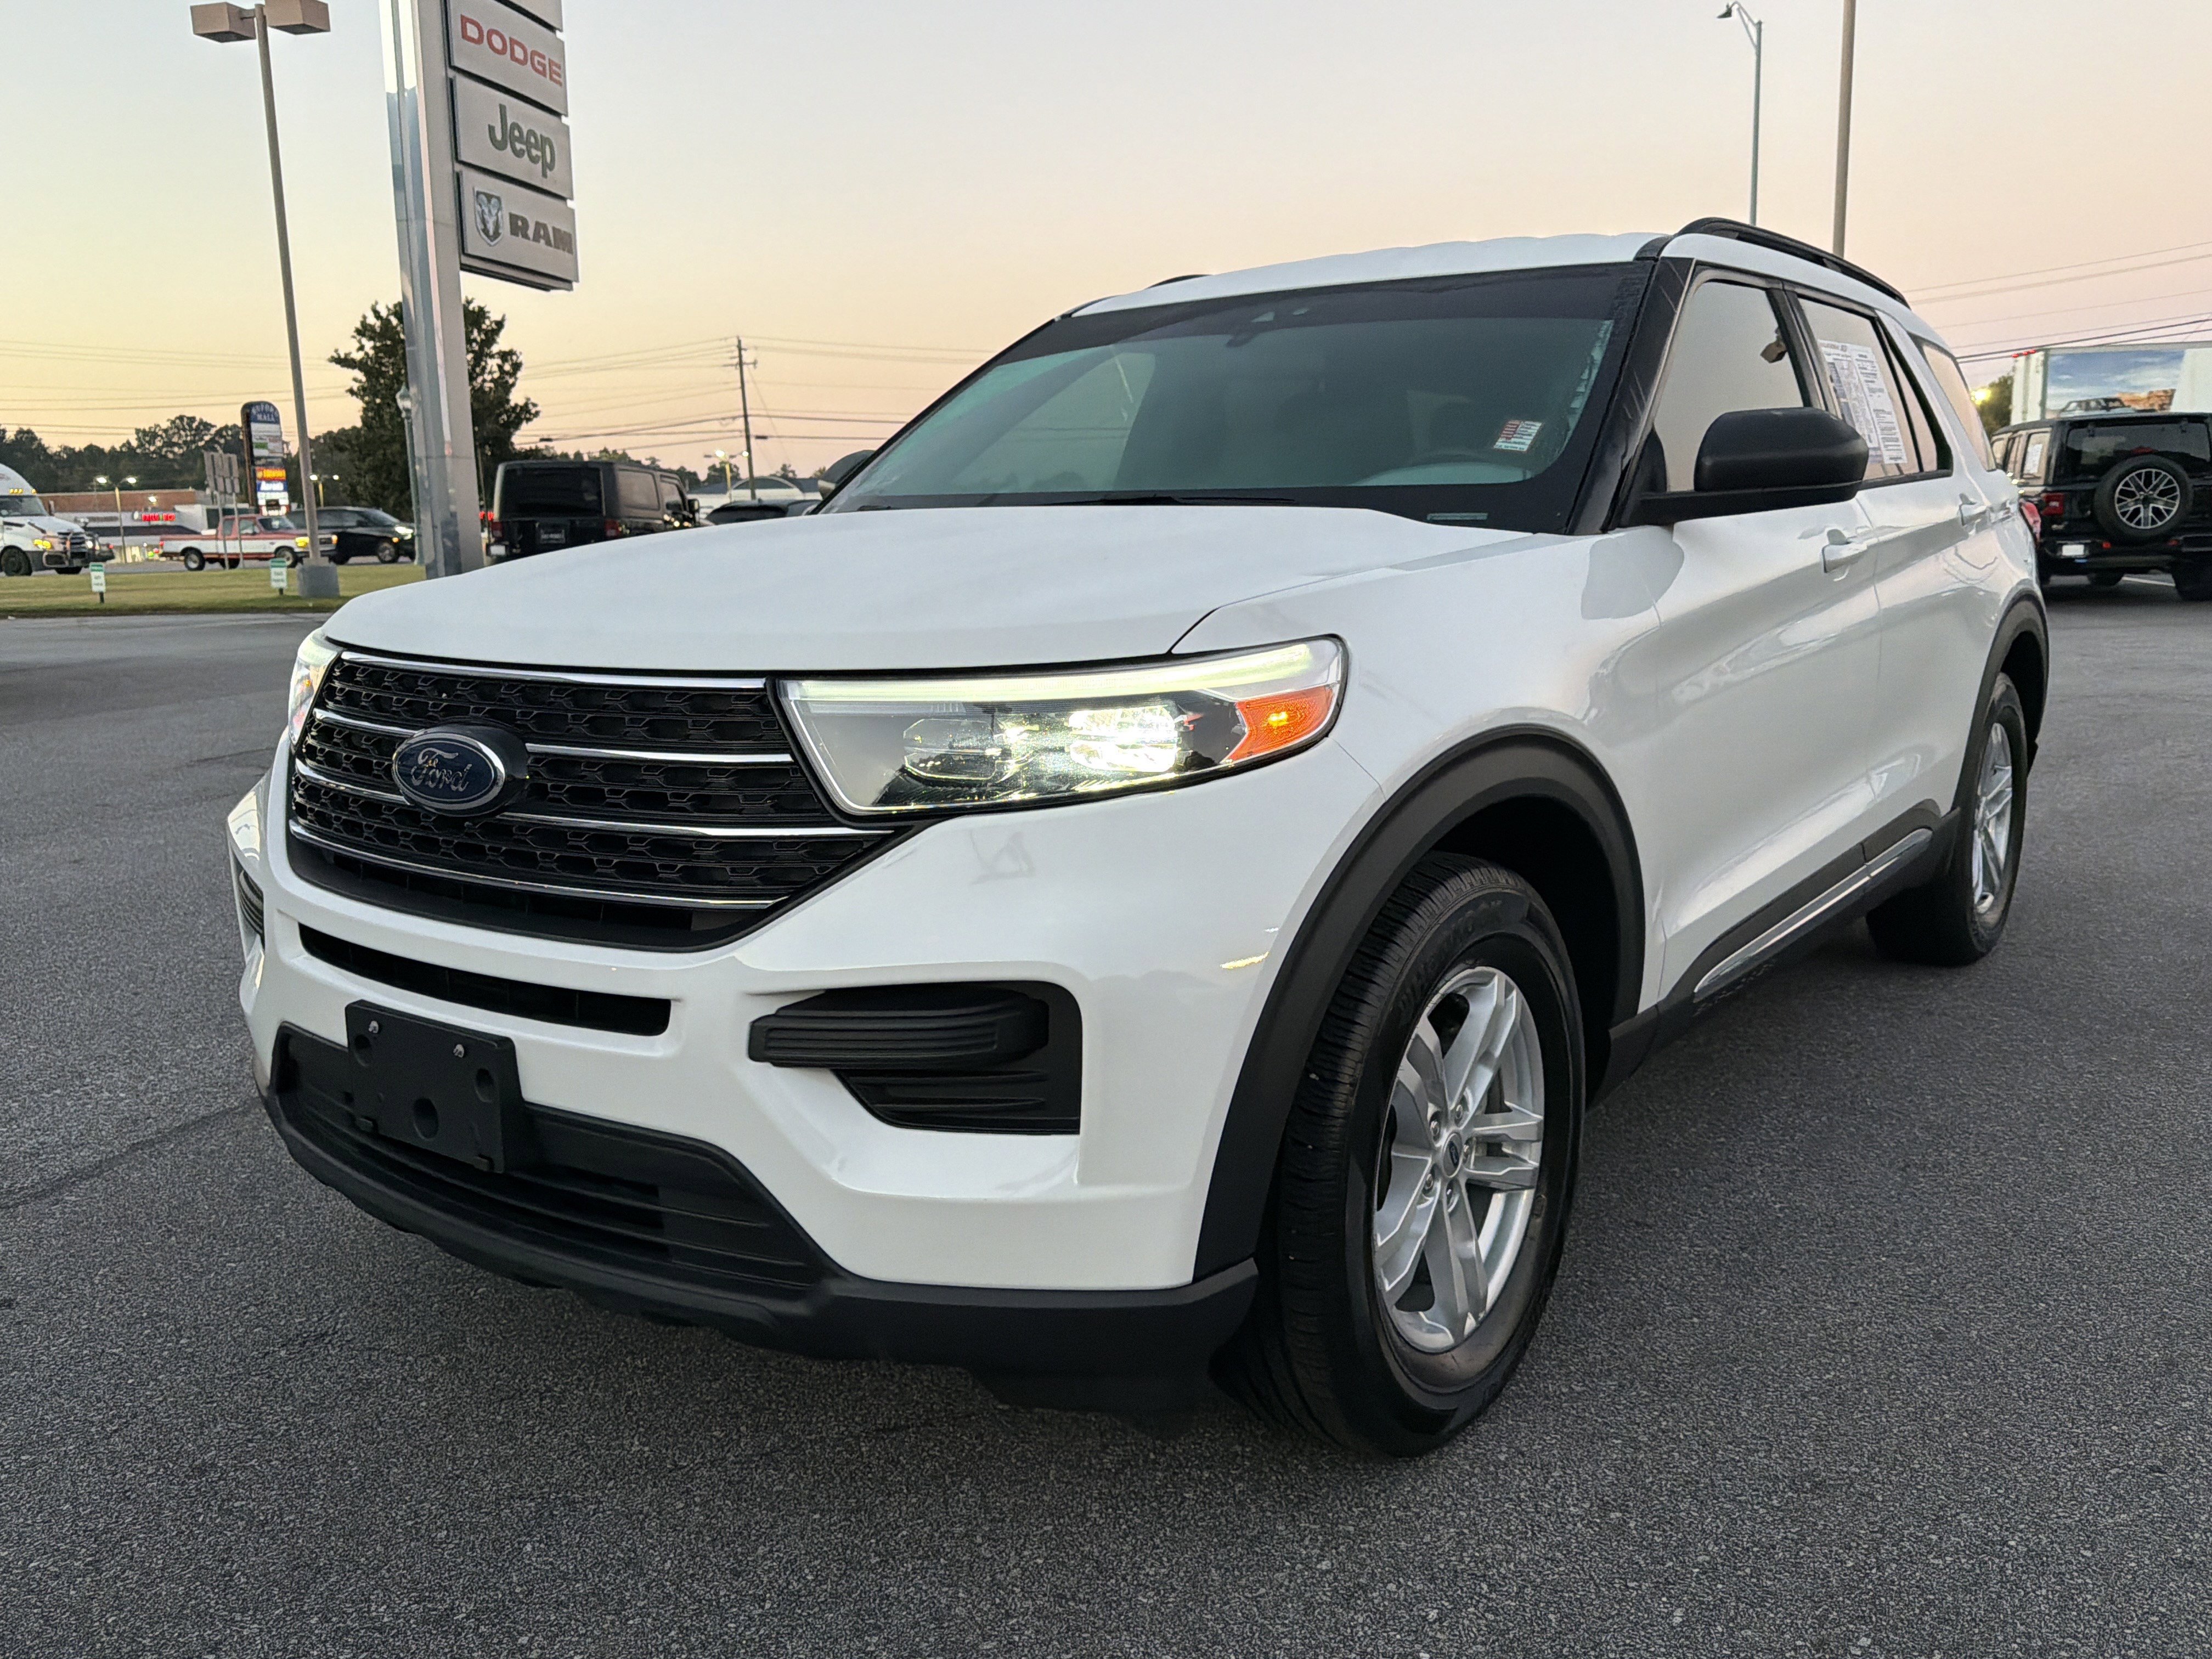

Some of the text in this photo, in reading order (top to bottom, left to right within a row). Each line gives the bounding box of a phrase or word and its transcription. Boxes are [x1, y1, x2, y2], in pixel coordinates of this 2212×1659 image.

[460, 14, 563, 87] DODGE
[488, 104, 556, 178] Jeep
[509, 212, 574, 255] RAM
[410, 747, 472, 792] Ford
